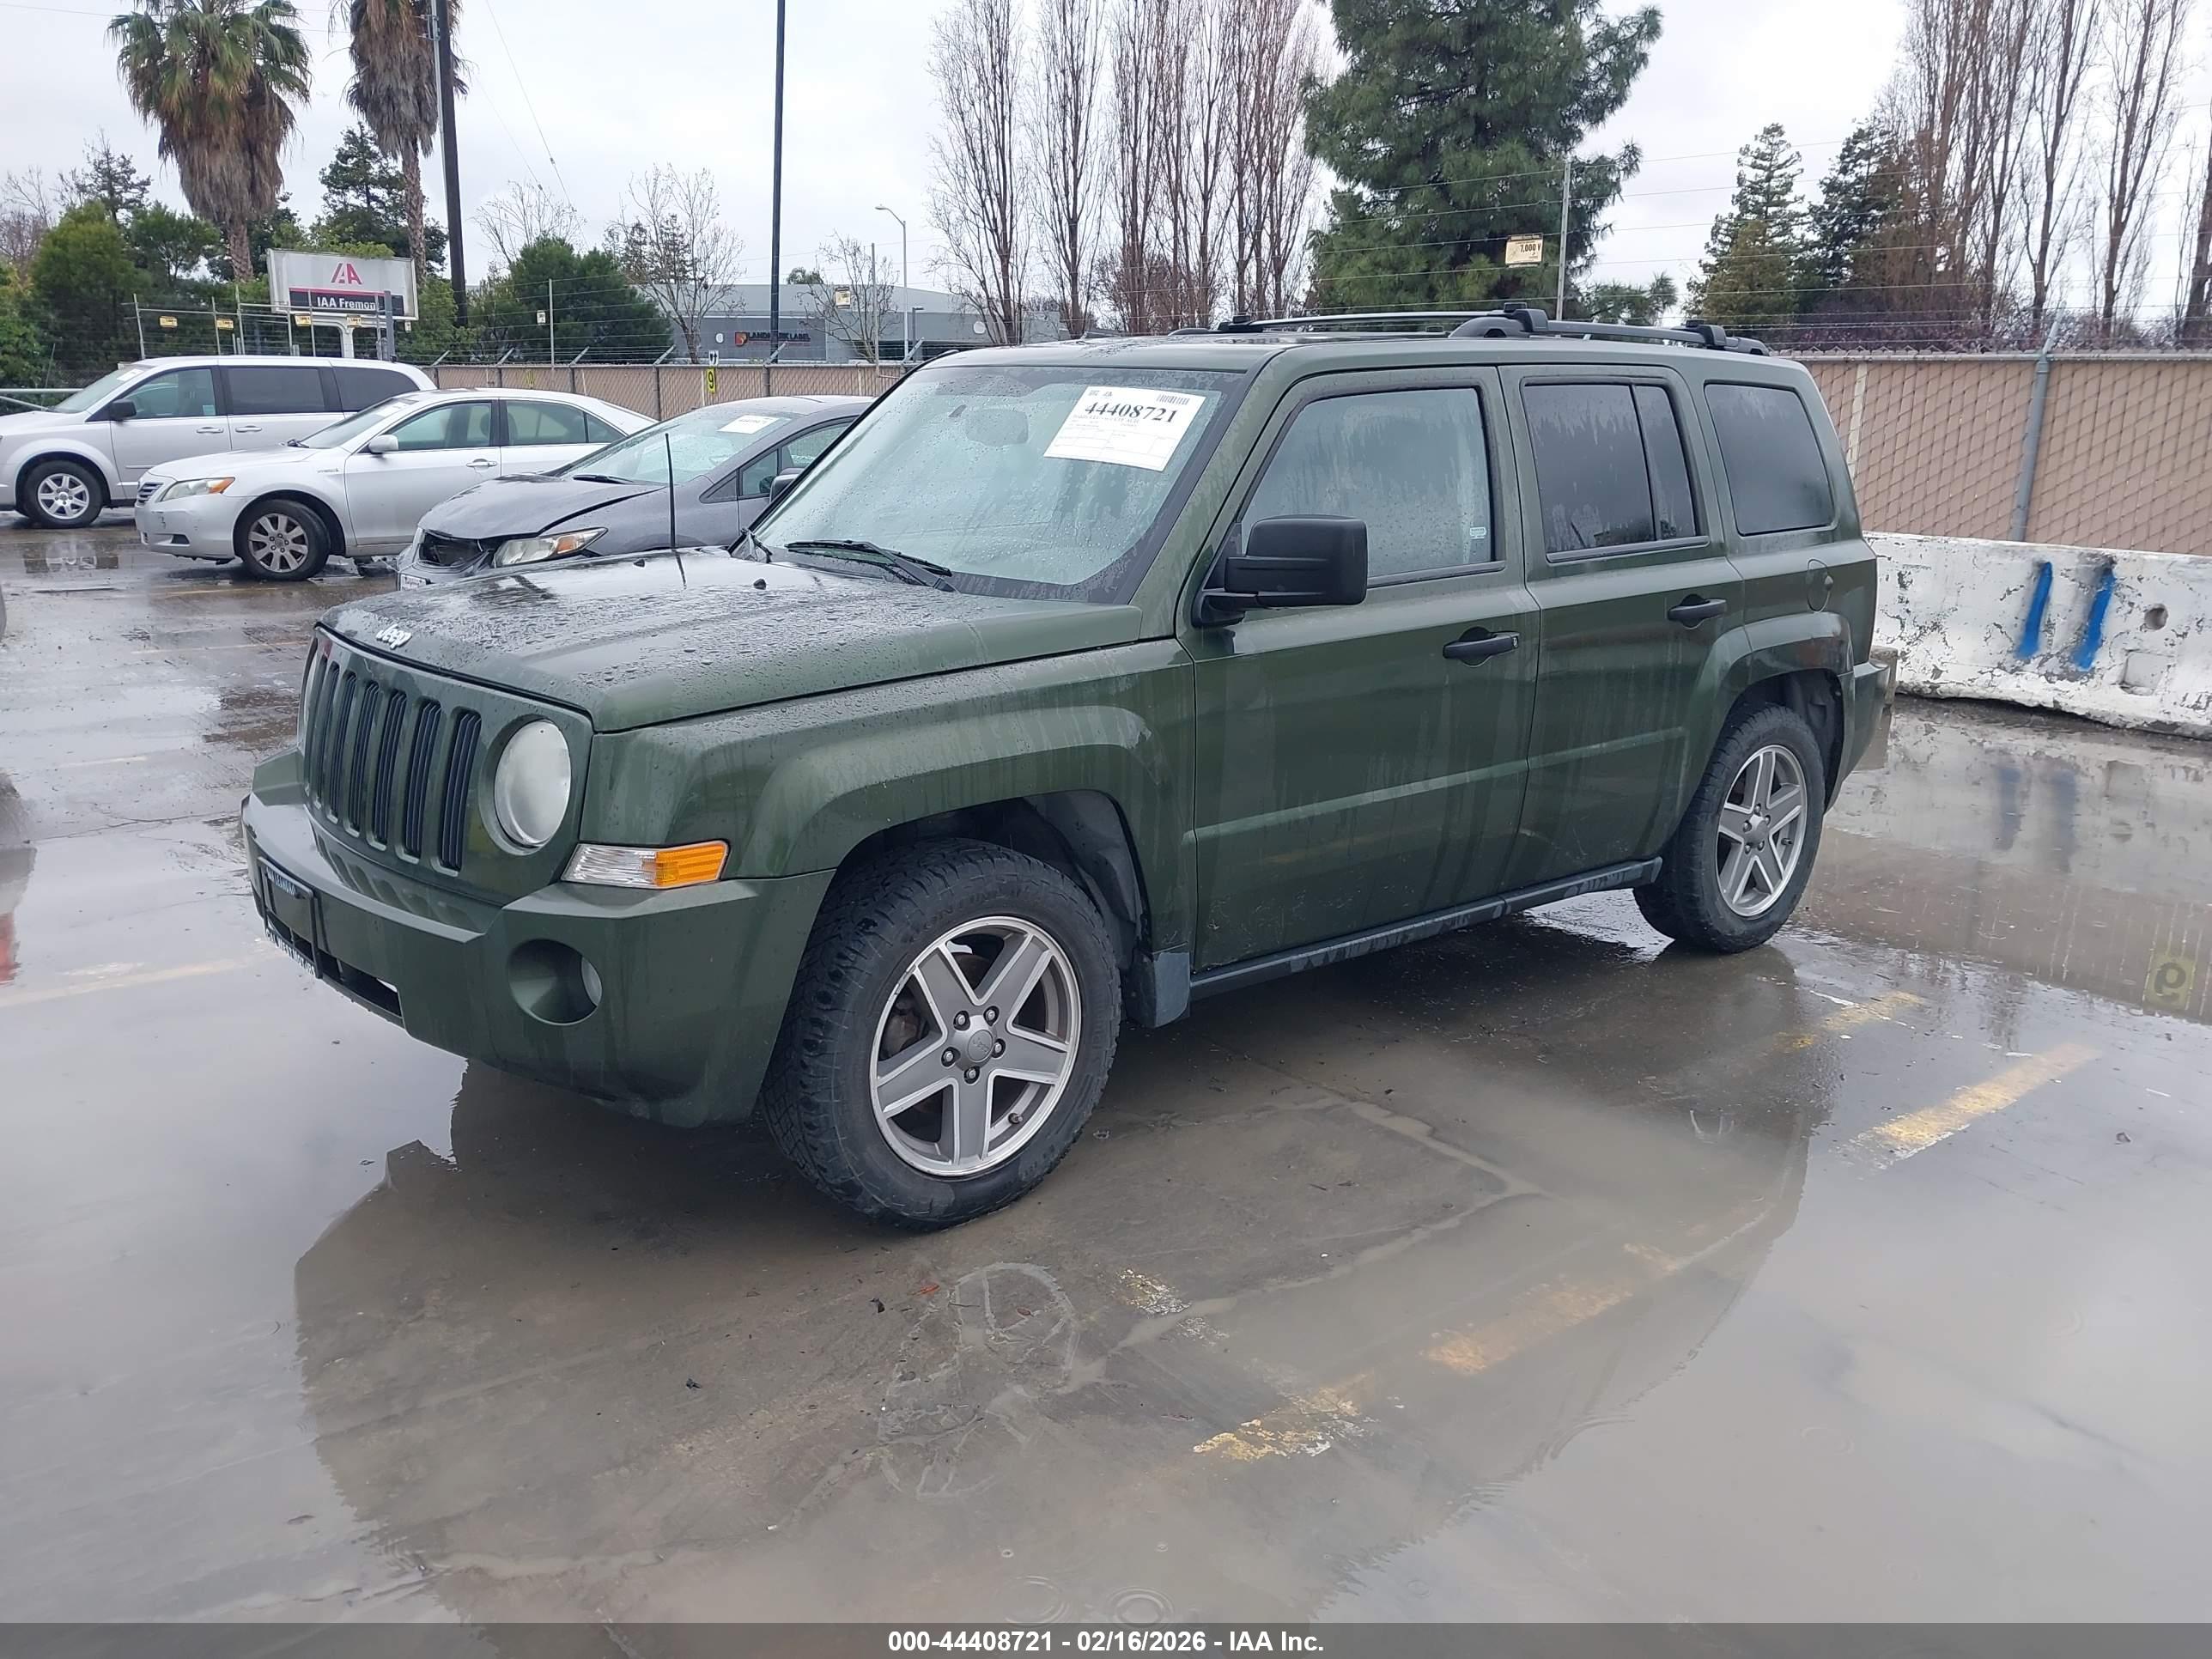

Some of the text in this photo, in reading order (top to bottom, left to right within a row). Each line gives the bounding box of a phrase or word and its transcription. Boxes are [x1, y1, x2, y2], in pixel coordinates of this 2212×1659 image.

[1520, 244, 1536, 252] 7,000
[317, 296, 379, 310] IAA Fremon
[708, 371, 714, 389] 9
[1085, 401, 1178, 423] 44408721
[375, 623, 412, 650] Jeep
